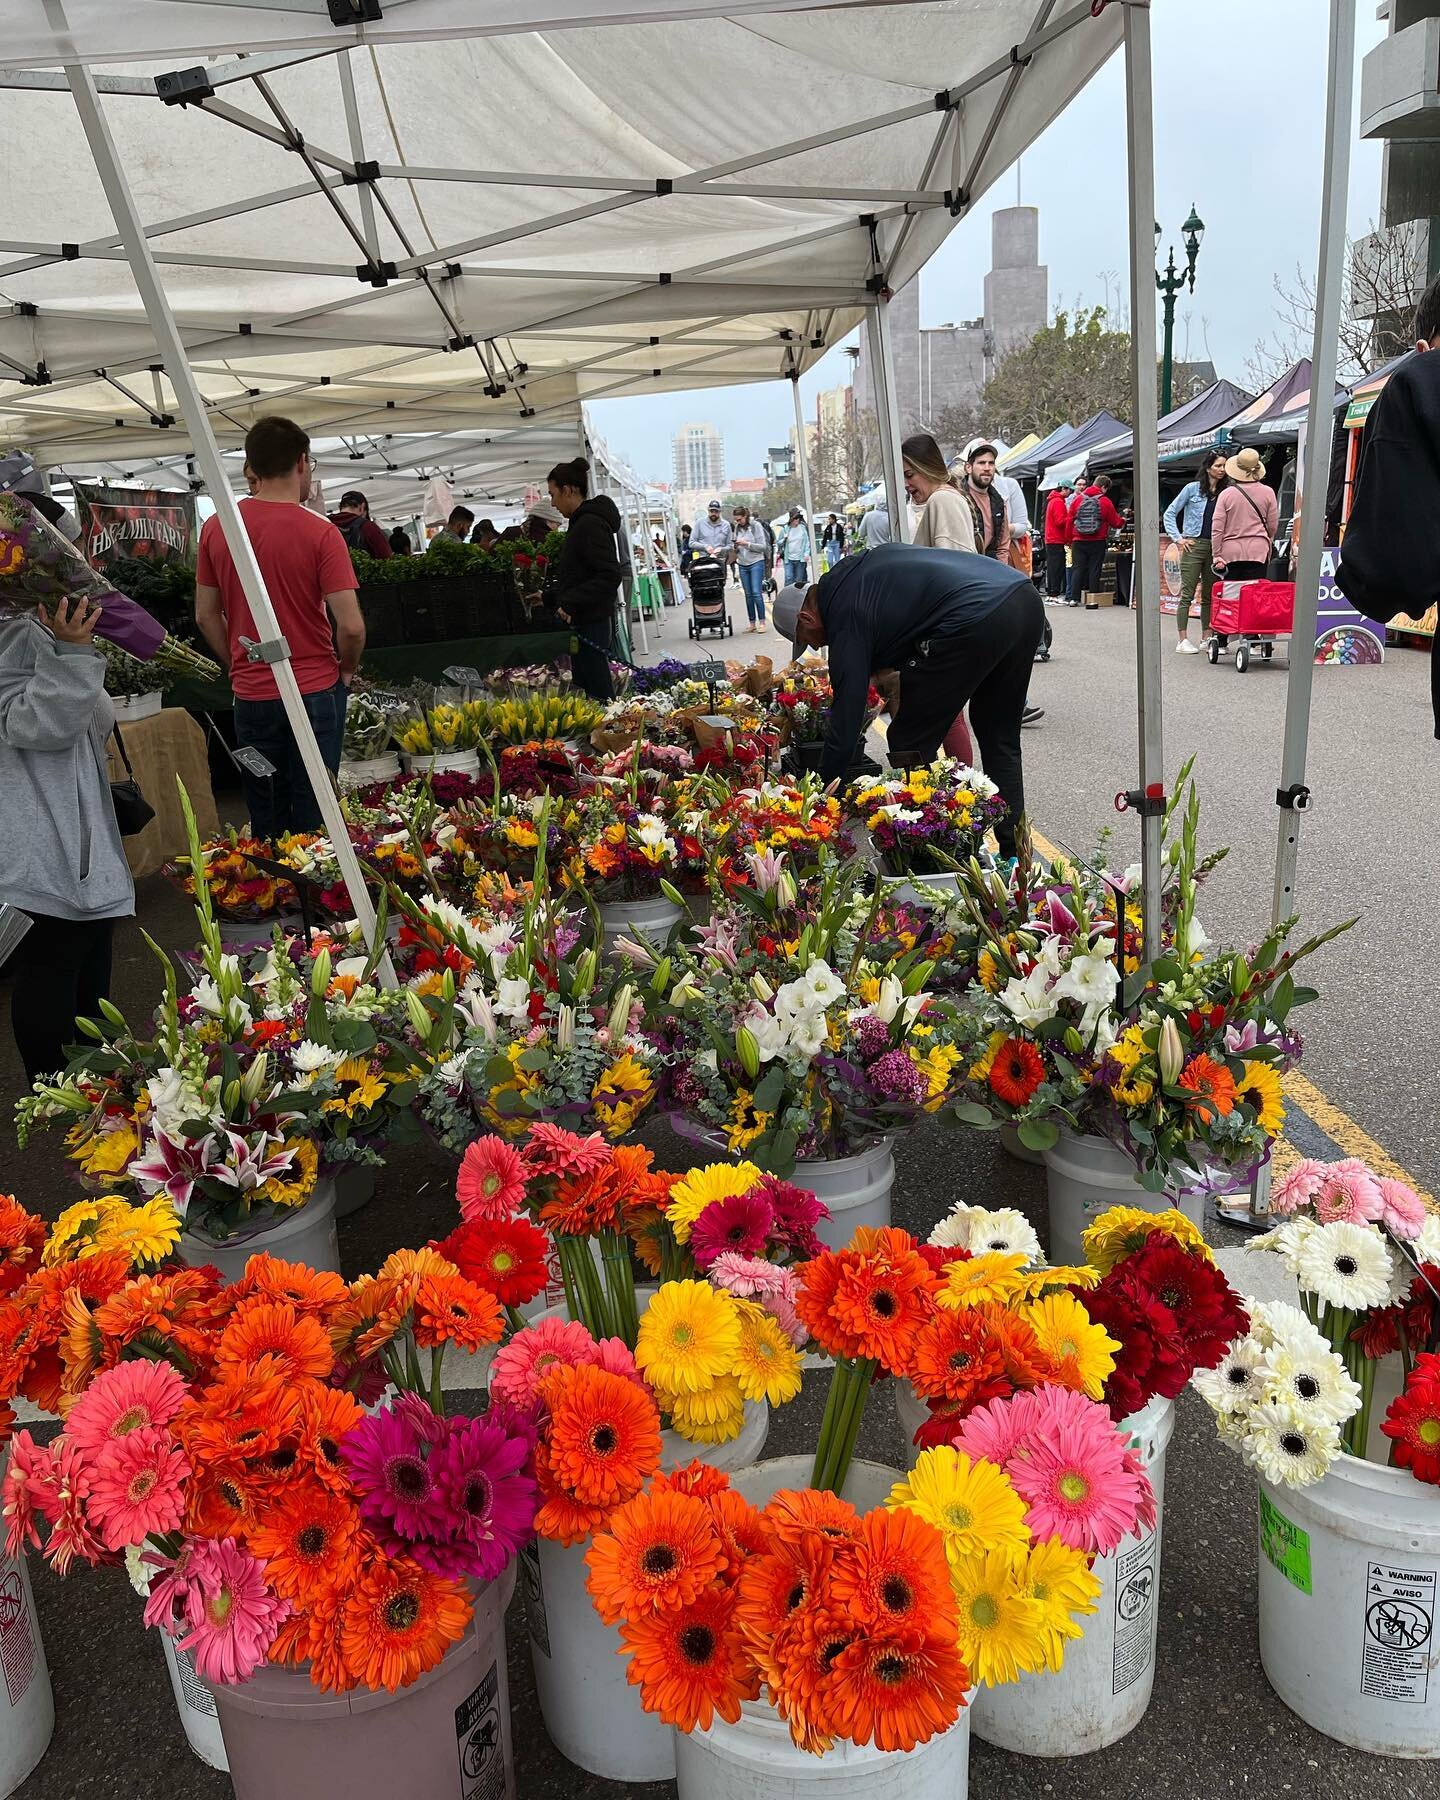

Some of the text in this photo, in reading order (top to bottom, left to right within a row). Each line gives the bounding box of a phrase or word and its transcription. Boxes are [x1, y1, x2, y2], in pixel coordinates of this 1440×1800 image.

[109, 518, 155, 544] FAMILY
[155, 519, 185, 555] FARM
[1388, 1570, 1433, 1583] WARNING
[1392, 1588, 1423, 1598] AVISO
[469, 1695, 490, 1727] AVISO
